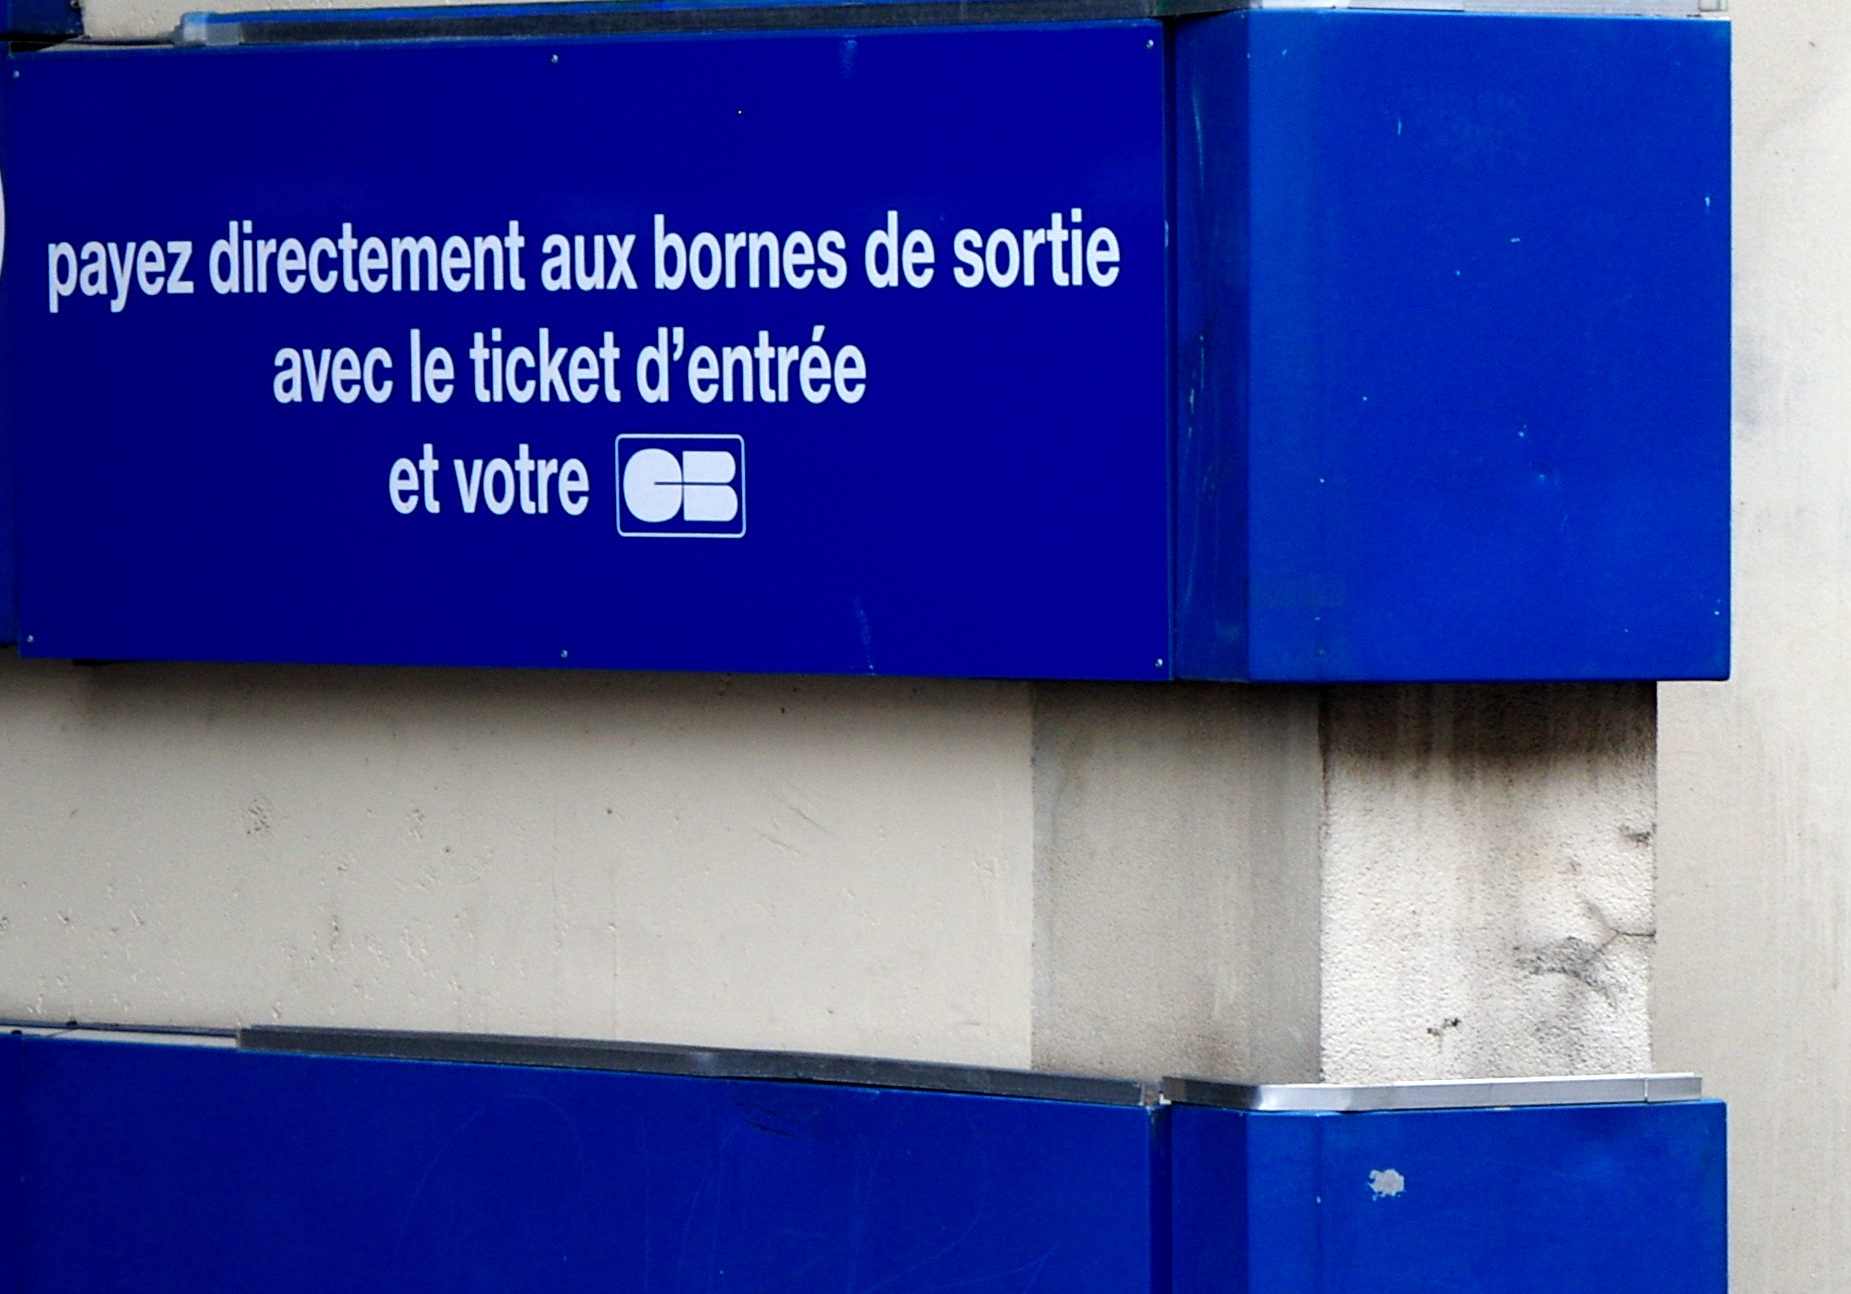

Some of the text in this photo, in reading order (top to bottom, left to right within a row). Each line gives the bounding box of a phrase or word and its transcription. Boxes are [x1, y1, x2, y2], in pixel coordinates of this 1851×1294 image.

[48, 207, 1120, 313] payez directement aux bornes de sortie
[273, 347, 393, 404] avec
[410, 327, 455, 404] le
[469, 326, 621, 404] ticket
[389, 443, 440, 514] et
[453, 443, 590, 516] votre
